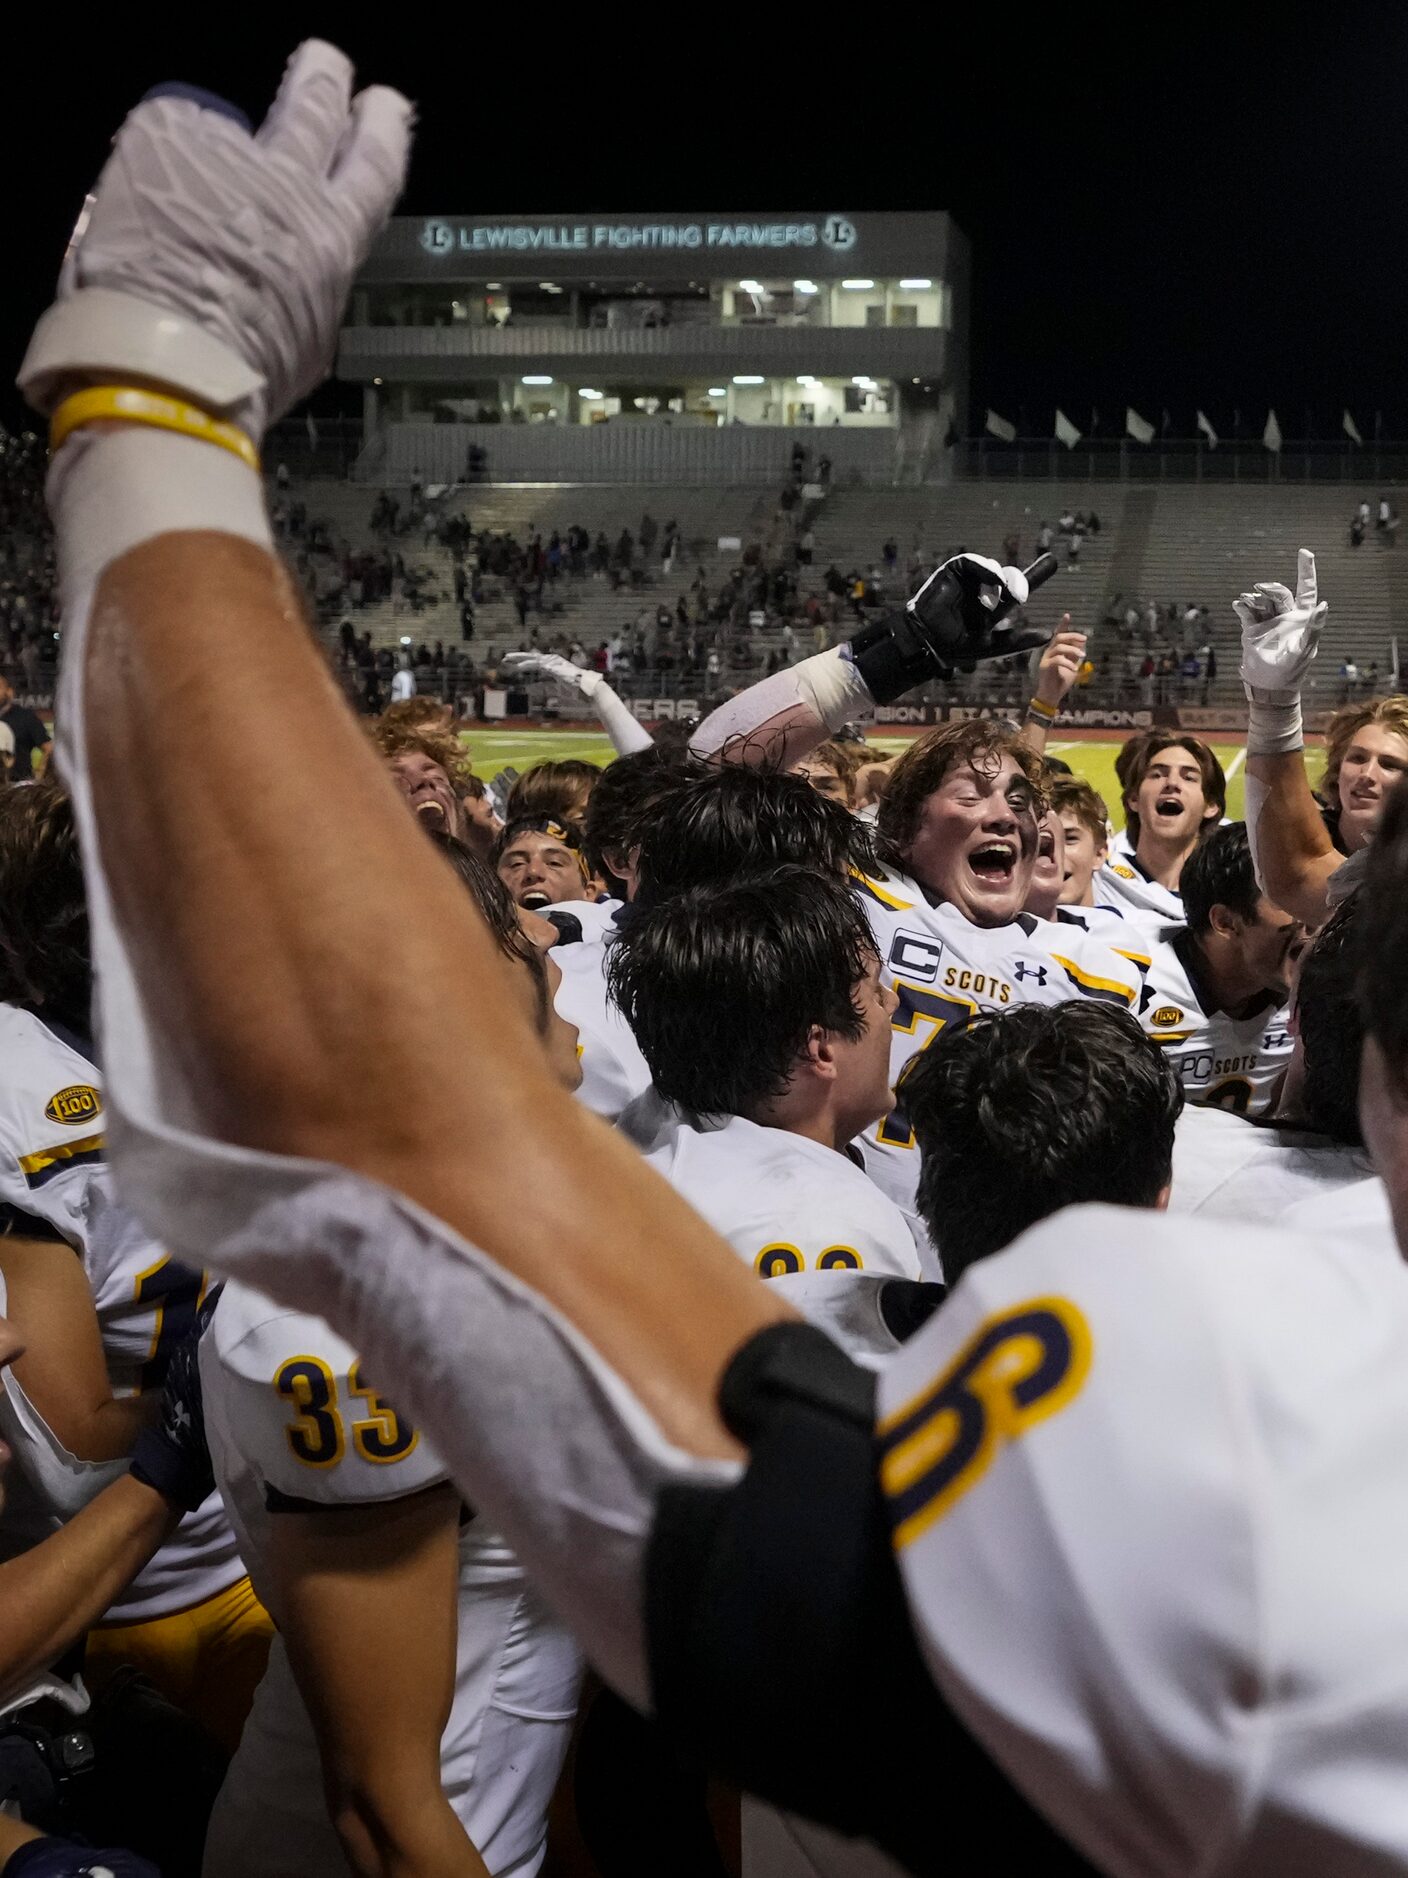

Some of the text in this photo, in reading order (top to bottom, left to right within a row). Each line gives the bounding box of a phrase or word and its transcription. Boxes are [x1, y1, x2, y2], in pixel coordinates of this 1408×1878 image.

[459, 227, 588, 250] LEWISVILLE
[594, 226, 701, 249] FIGHTING
[707, 223, 817, 248] FARMERS
[889, 935, 941, 975] C
[944, 967, 1012, 1003] SCOTS
[1214, 1054, 1258, 1075] SCOTS
[61, 1096, 94, 1117] 100
[273, 1354, 422, 1470] 33
